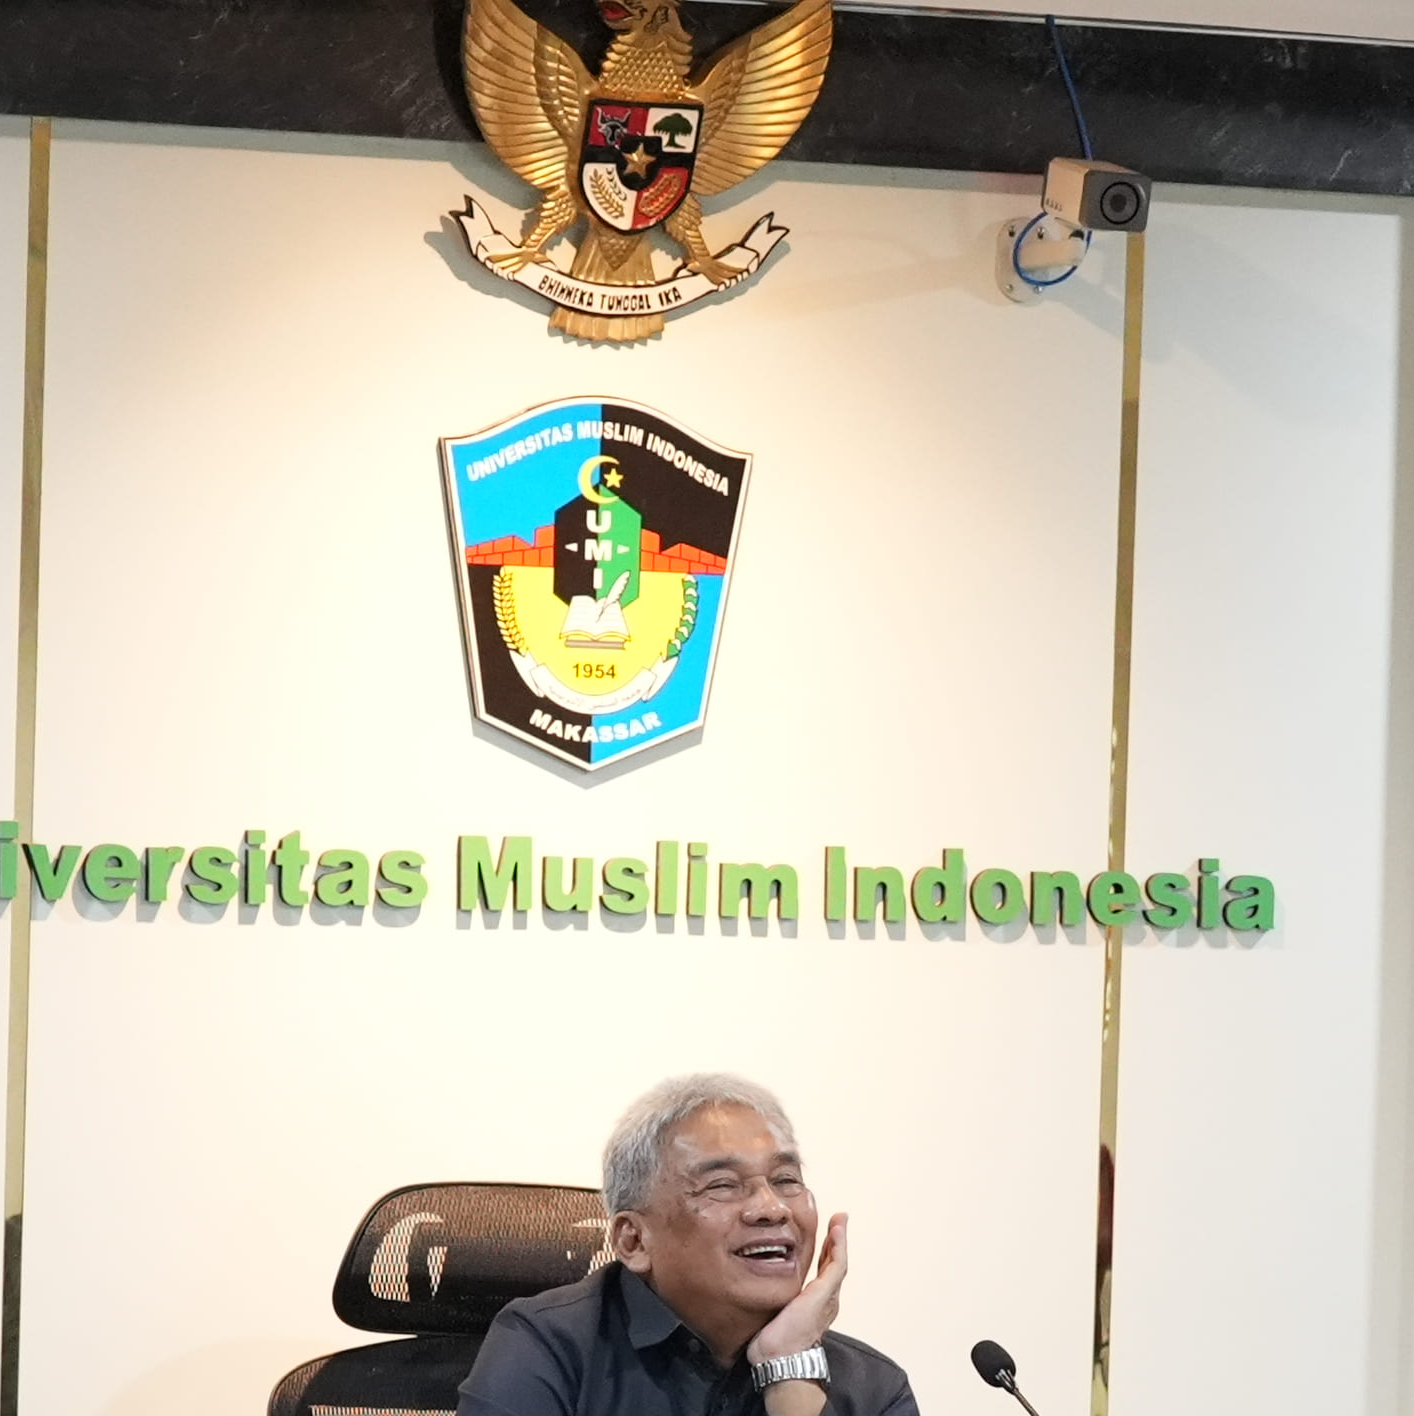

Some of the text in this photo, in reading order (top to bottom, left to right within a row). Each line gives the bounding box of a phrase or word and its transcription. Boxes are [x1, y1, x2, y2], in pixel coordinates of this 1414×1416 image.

[601, 294, 651, 311] TUNGGAL
[659, 287, 682, 307] IKA
[466, 421, 729, 496] UNIVERSITAS MUSLIM INDONESIA
[572, 663, 617, 679] 1954
[529, 709, 662, 743] MAKASSAR
[457, 835, 799, 920] Muslim
[824, 846, 1276, 931] Indonesia
